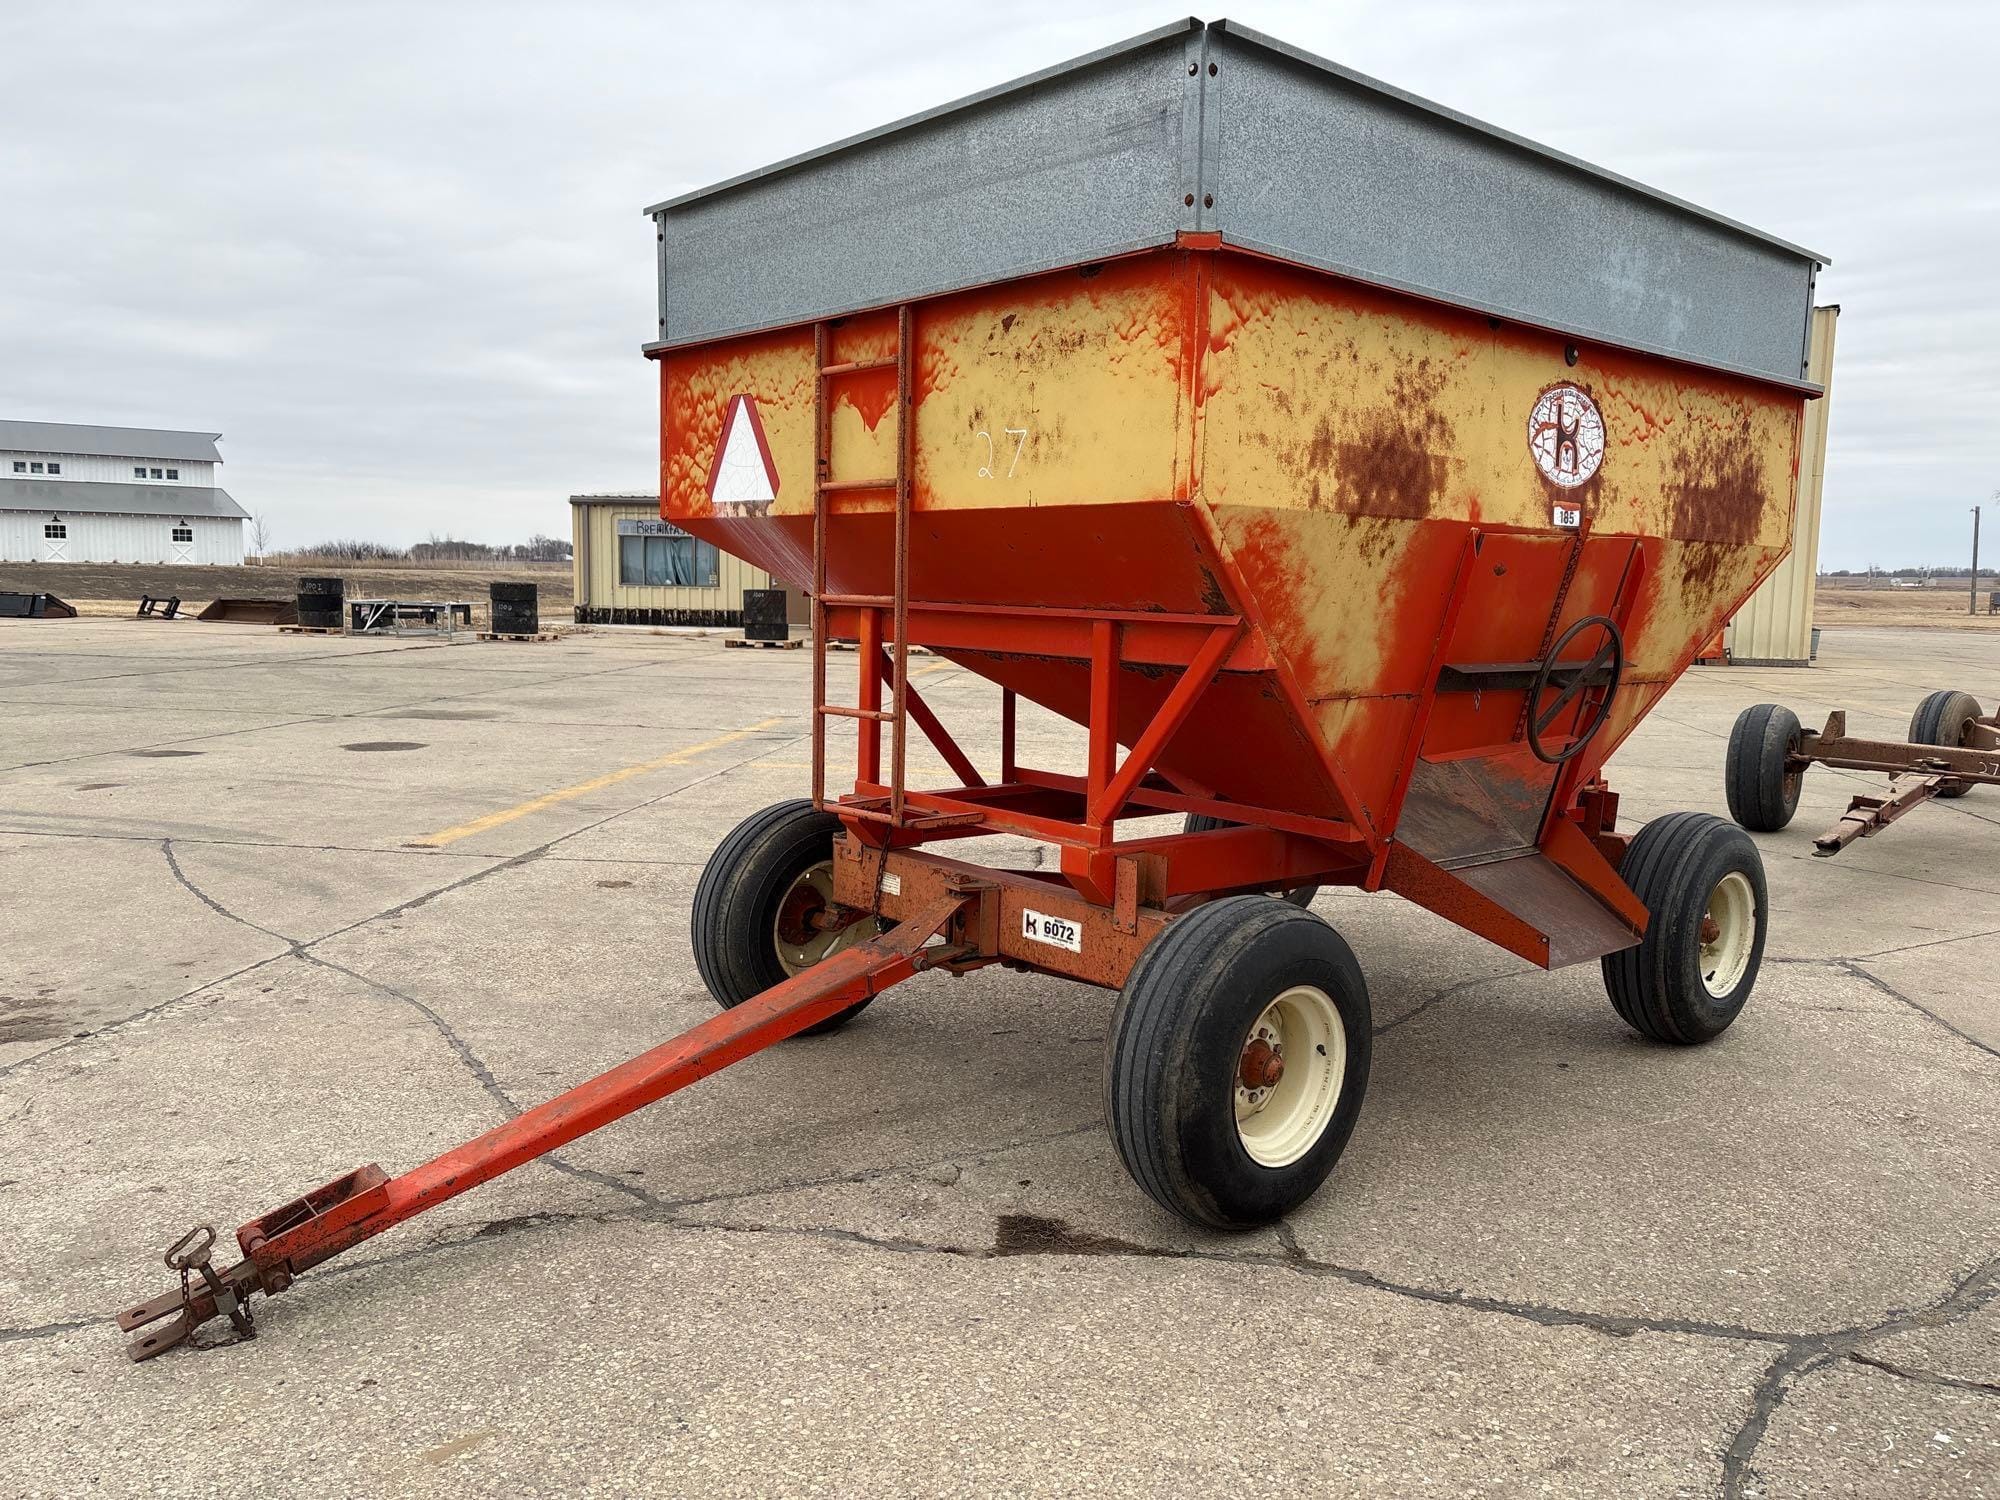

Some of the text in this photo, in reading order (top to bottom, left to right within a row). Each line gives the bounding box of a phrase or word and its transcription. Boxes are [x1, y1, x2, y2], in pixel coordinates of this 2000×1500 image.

[976, 427, 1027, 479] 27
[1559, 511, 1575, 525] 185
[1044, 921, 1075, 941] 6072
